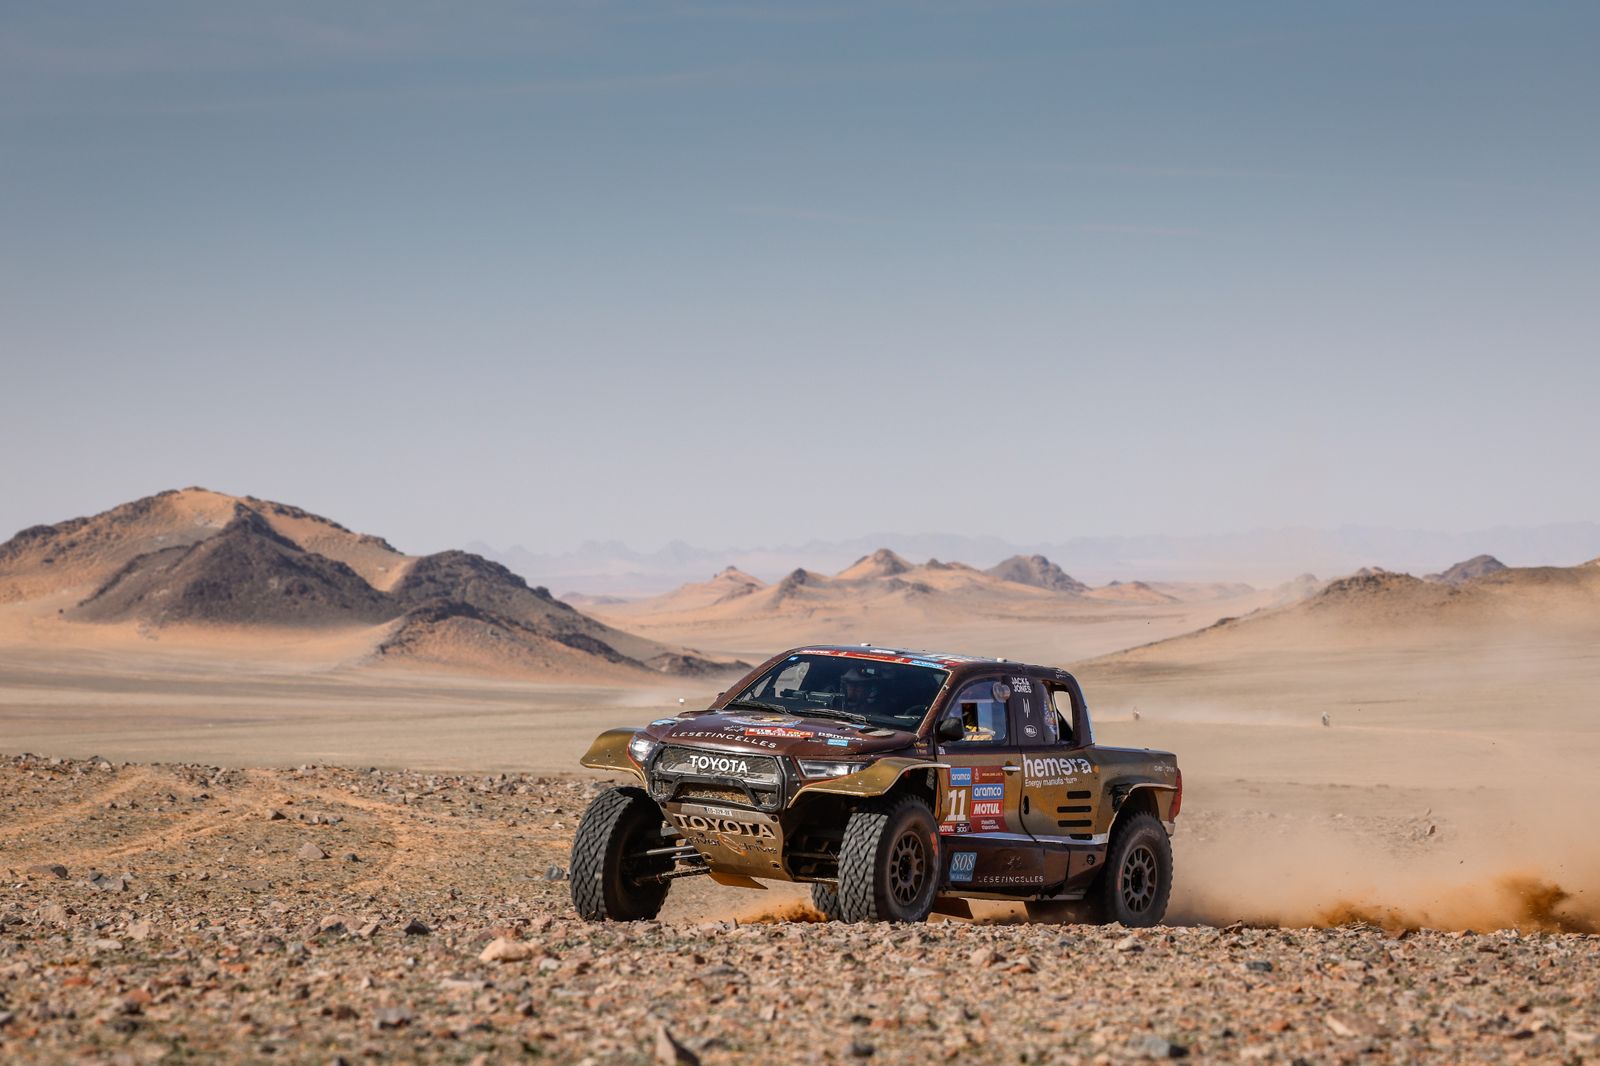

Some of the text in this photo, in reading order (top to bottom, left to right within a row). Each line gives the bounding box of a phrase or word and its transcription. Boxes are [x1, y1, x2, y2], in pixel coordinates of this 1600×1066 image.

[1013, 684, 1032, 694] JONES
[1025, 727, 1036, 735] BELL
[672, 731, 777, 749] LESETINCELLES
[689, 755, 748, 773] TOYOTA
[1022, 753, 1093, 778] hemera
[951, 773, 971, 781] aramco
[1025, 779, 1042, 788] Energy
[974, 786, 1002, 797] aramco
[944, 789, 966, 822] 11
[973, 803, 1000, 815] MOTUL
[672, 813, 777, 840] TOYOTA
[952, 854, 975, 871] 808
